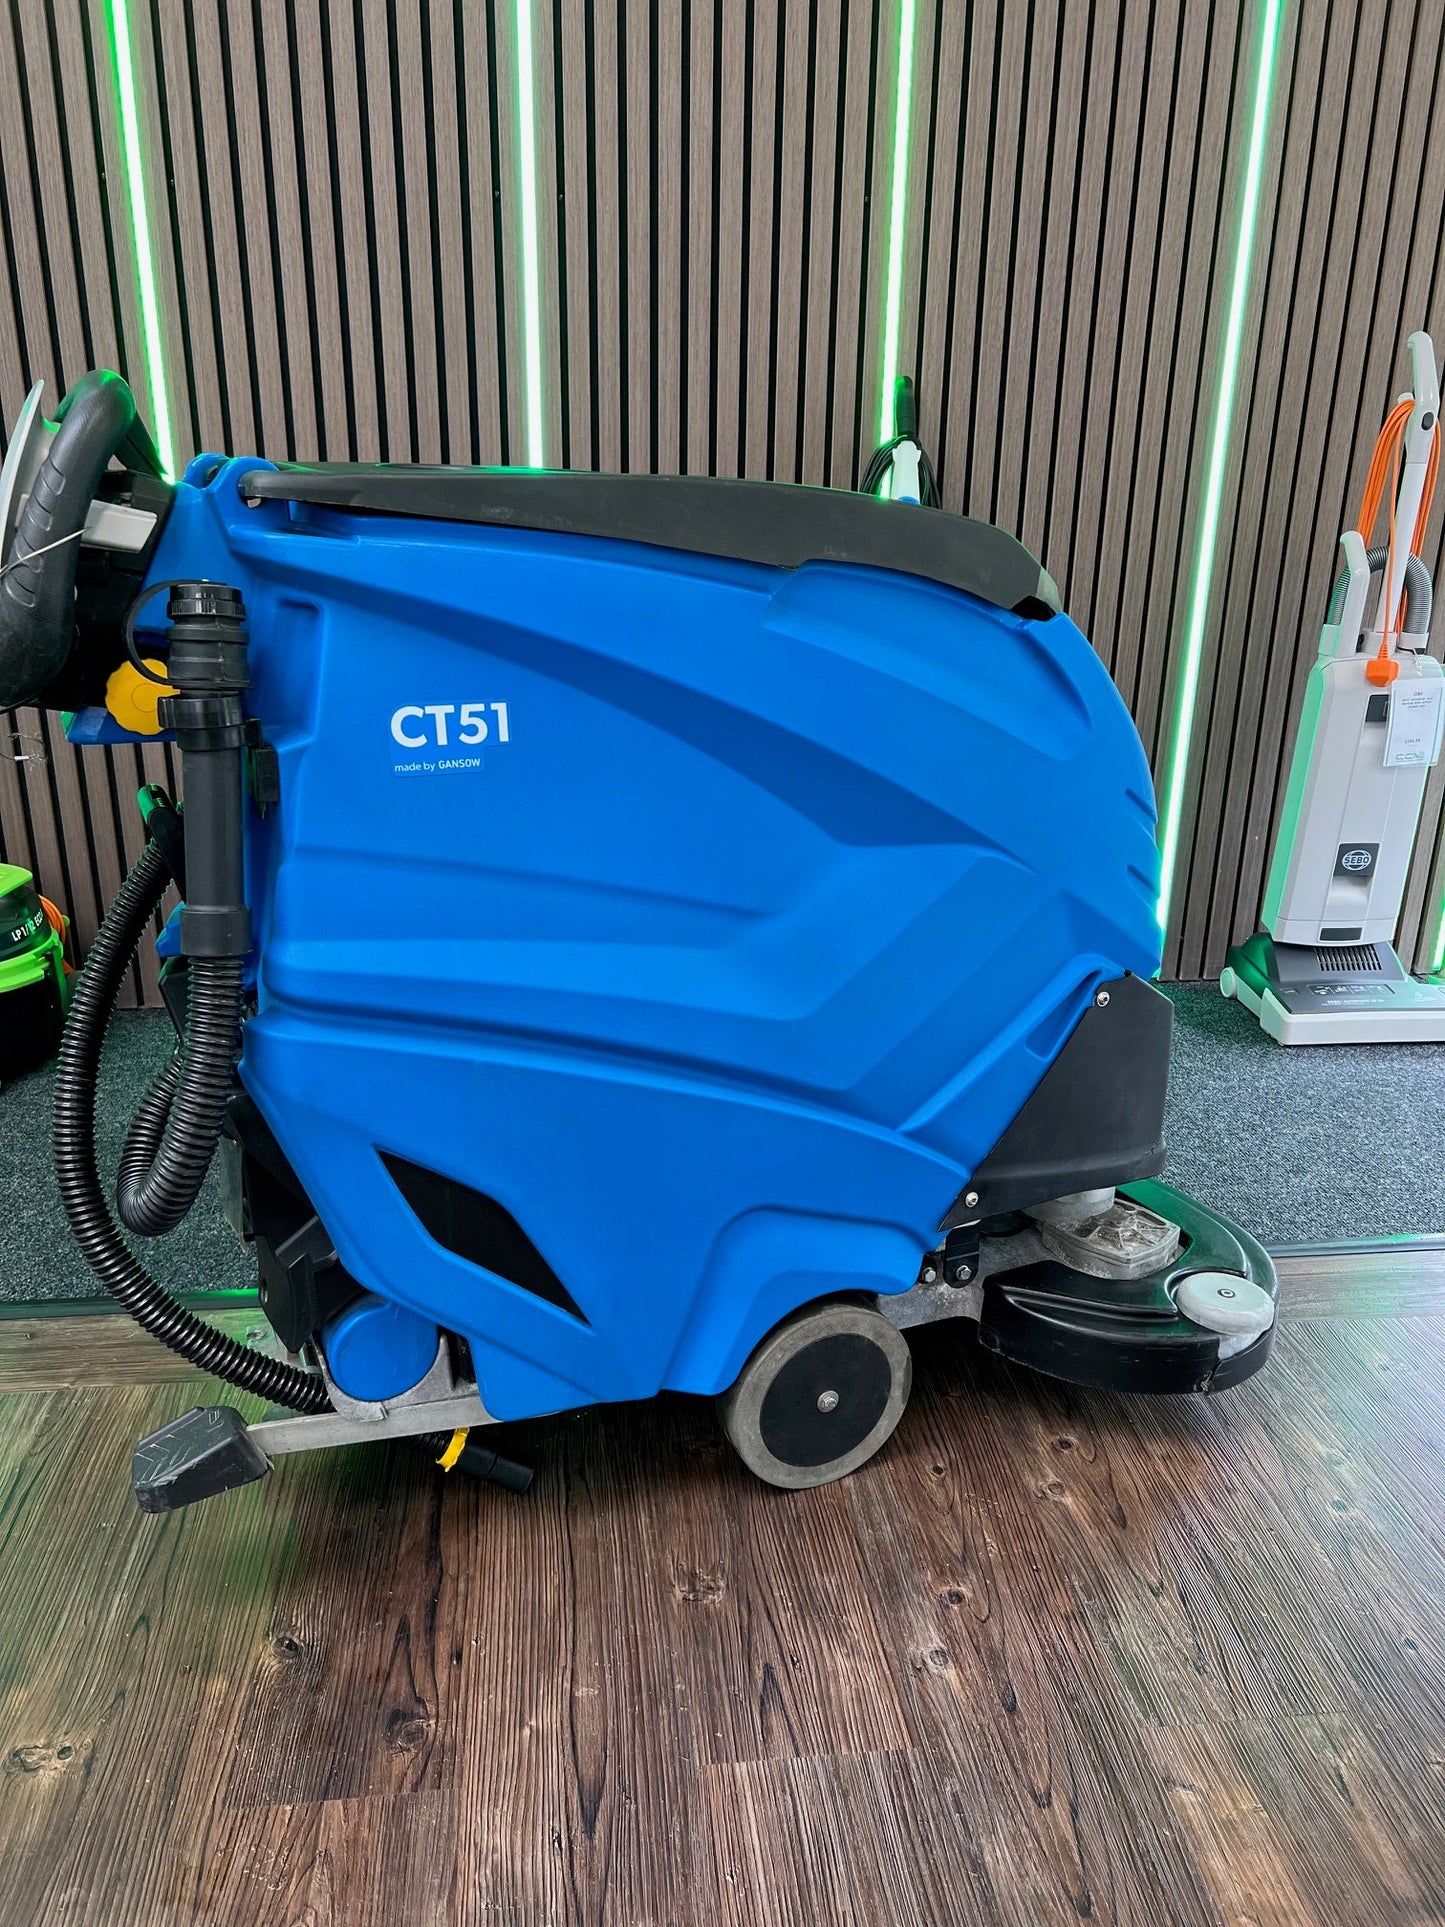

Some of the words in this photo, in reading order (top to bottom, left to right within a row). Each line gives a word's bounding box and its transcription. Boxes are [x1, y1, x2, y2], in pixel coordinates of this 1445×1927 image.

[390, 702, 509, 748] CT51
[394, 763, 421, 772] made
[423, 762, 435, 772] by
[438, 758, 480, 769] GANSOW
[1344, 856, 1370, 864] SEBO
